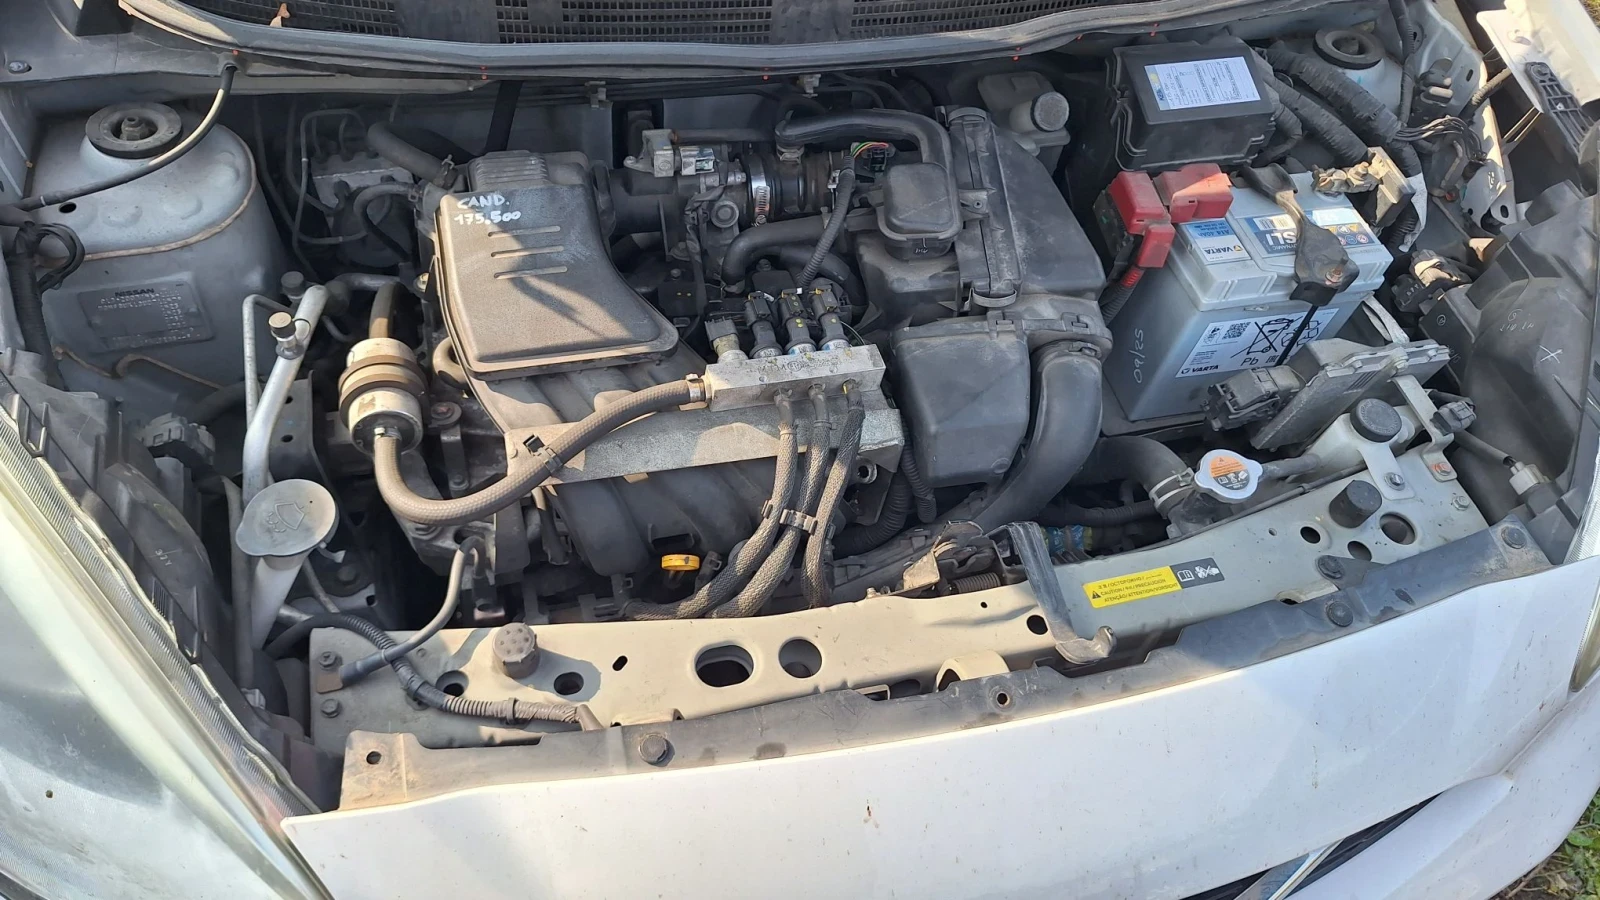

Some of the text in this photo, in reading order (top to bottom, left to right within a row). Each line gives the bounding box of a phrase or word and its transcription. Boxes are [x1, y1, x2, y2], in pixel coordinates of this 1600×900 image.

[457, 194, 510, 210] CAND.
[454, 210, 522, 226] 175.500
[1265, 231, 1297, 246] SLI
[1203, 246, 1234, 255] VARTA
[115, 288, 155, 297] NISSAN
[1240, 356, 1259, 366] Pb
[1192, 364, 1219, 373] VARTA
